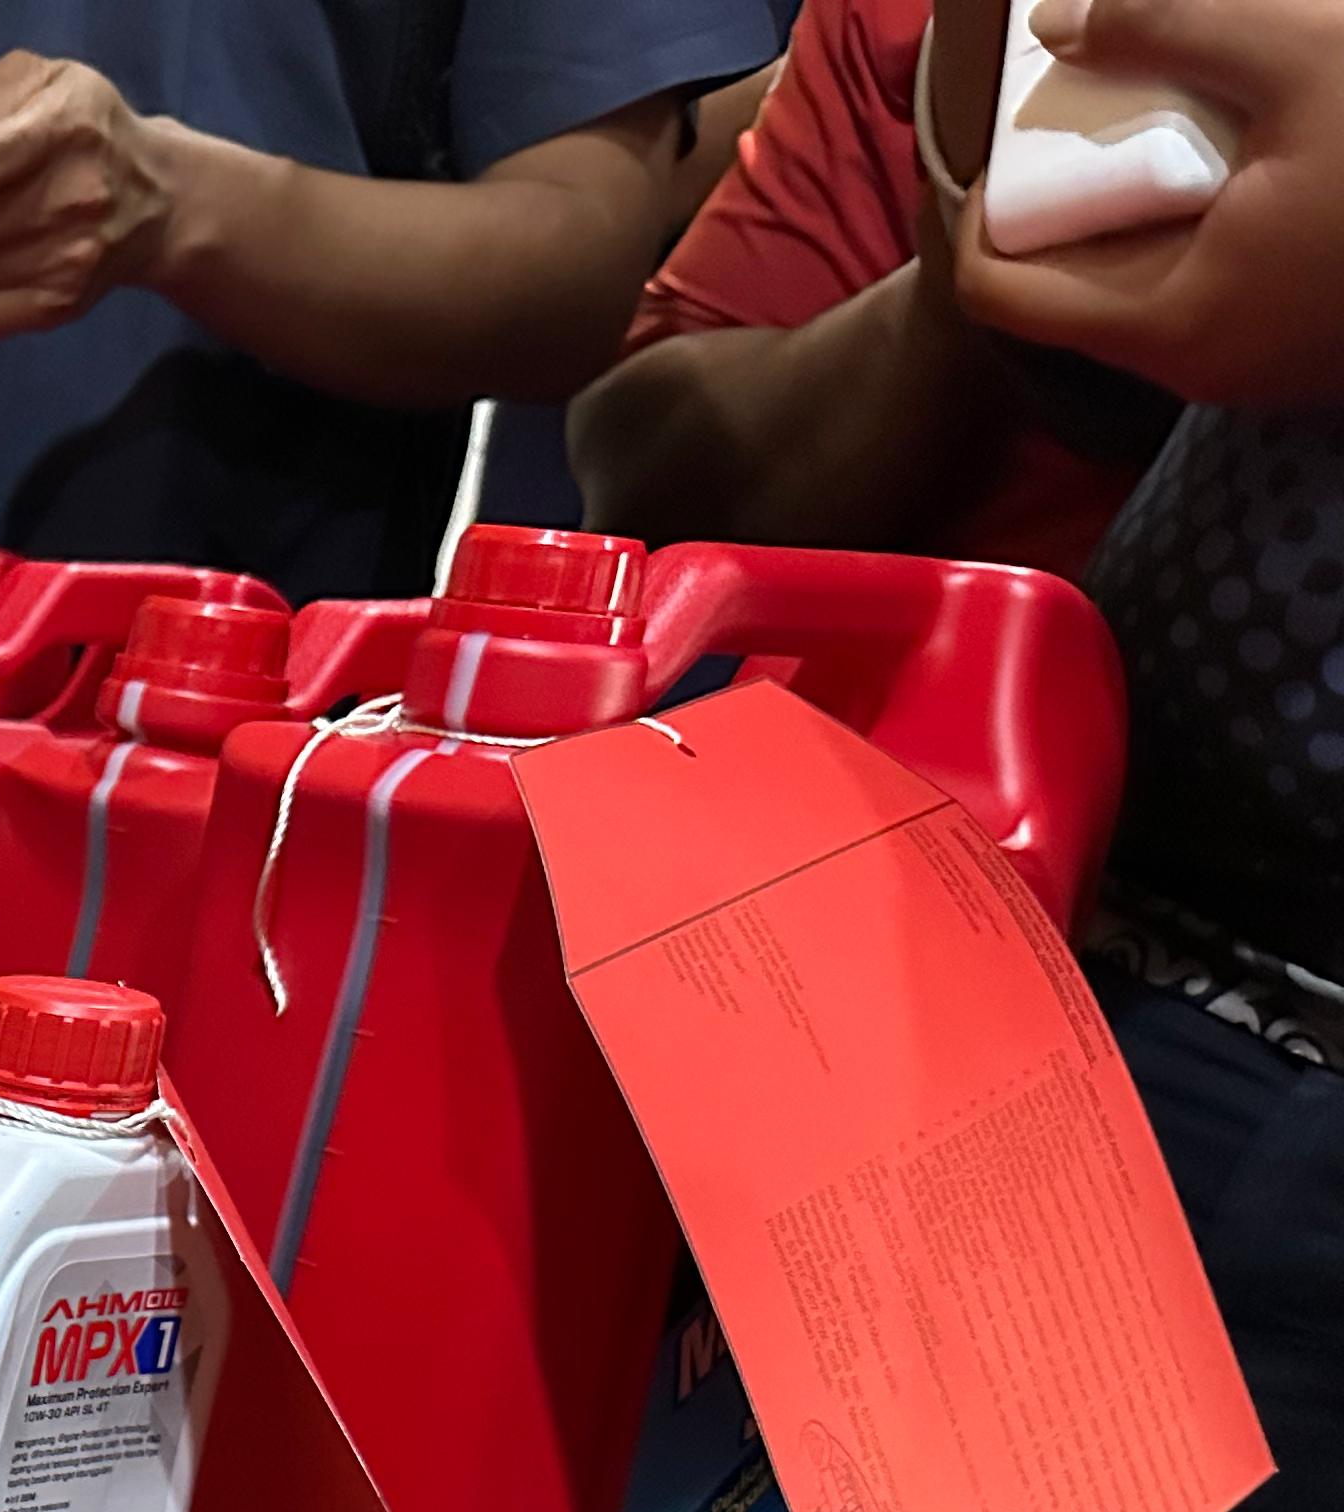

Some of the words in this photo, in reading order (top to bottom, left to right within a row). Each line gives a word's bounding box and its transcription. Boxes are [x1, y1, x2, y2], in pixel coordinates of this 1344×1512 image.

[26, 1390, 75, 1408] Maximum
[76, 1382, 132, 1401] Protection
[132, 1379, 170, 1396] Expert
[23, 1408, 63, 1423] 10W-30
[63, 1405, 81, 1418] API
[81, 1403, 95, 1416] SL
[96, 1401, 111, 1413] 4T
